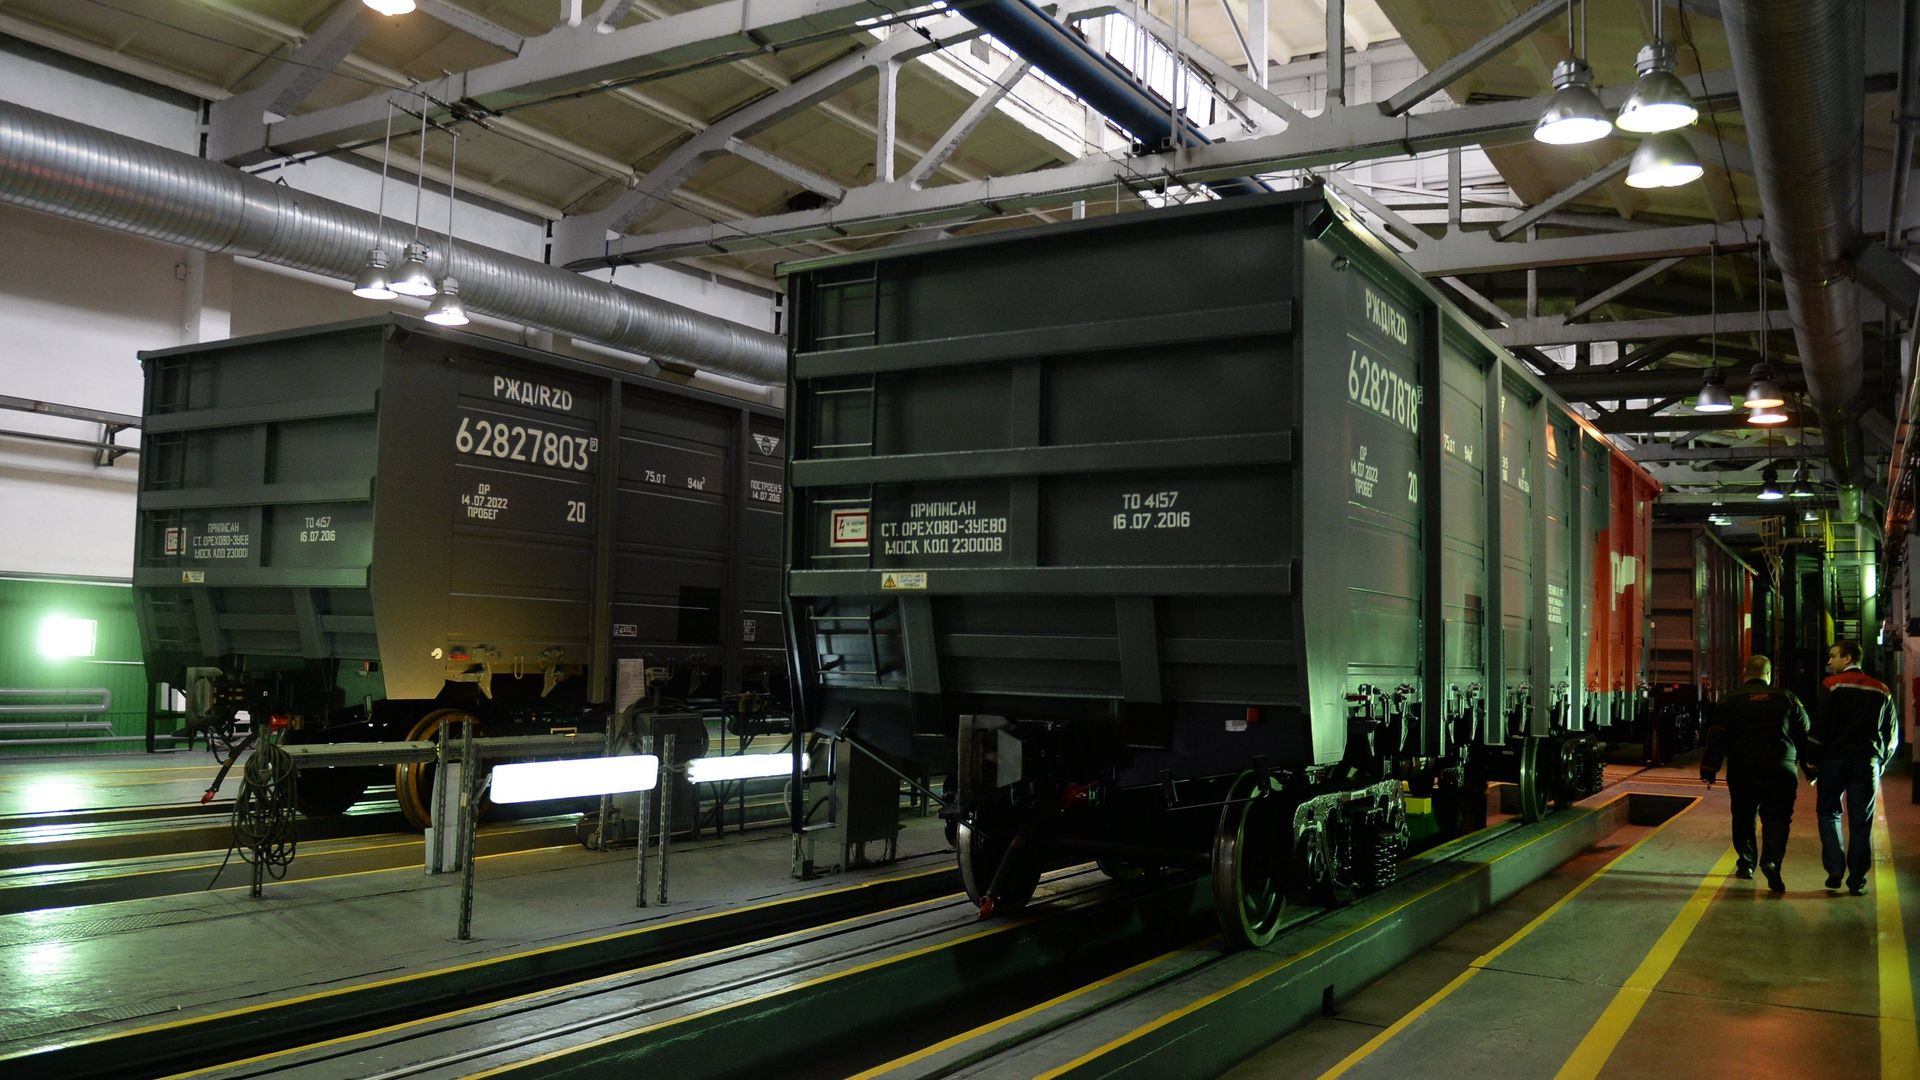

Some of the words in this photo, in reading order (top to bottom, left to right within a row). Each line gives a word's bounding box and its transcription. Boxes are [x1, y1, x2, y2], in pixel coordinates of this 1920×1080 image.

[1366, 288, 1407, 345] РЖД/RZD
[493, 375, 573, 411] РЖД/RZD
[1348, 350, 1418, 434] 62827878
[455, 417, 589, 471] 62827803
[478, 484, 490, 495] ДР
[750, 480, 778, 493] ПОСТРОЕН
[1408, 471, 1418, 503] 20
[462, 495, 508, 509] 14.07.2022
[752, 491, 781, 503] 14.07.2016
[1122, 493, 1141, 510] ТО
[1144, 491, 1178, 509] 4157
[468, 508, 499, 520] ПРОБЕГ
[567, 501, 586, 523] 20
[911, 501, 976, 518] ПРИПИСАН
[207, 522, 239, 533] ПРИПИСАН
[305, 517, 314, 528] ТО
[881, 523, 898, 537] СТ.
[902, 518, 1007, 537] ОРЕХОВО-ЗУЕВО
[194, 549, 212, 559] МОСК
[885, 540, 919, 555] МОСК
[923, 540, 949, 553] КОД
[952, 537, 1002, 553] 230008
